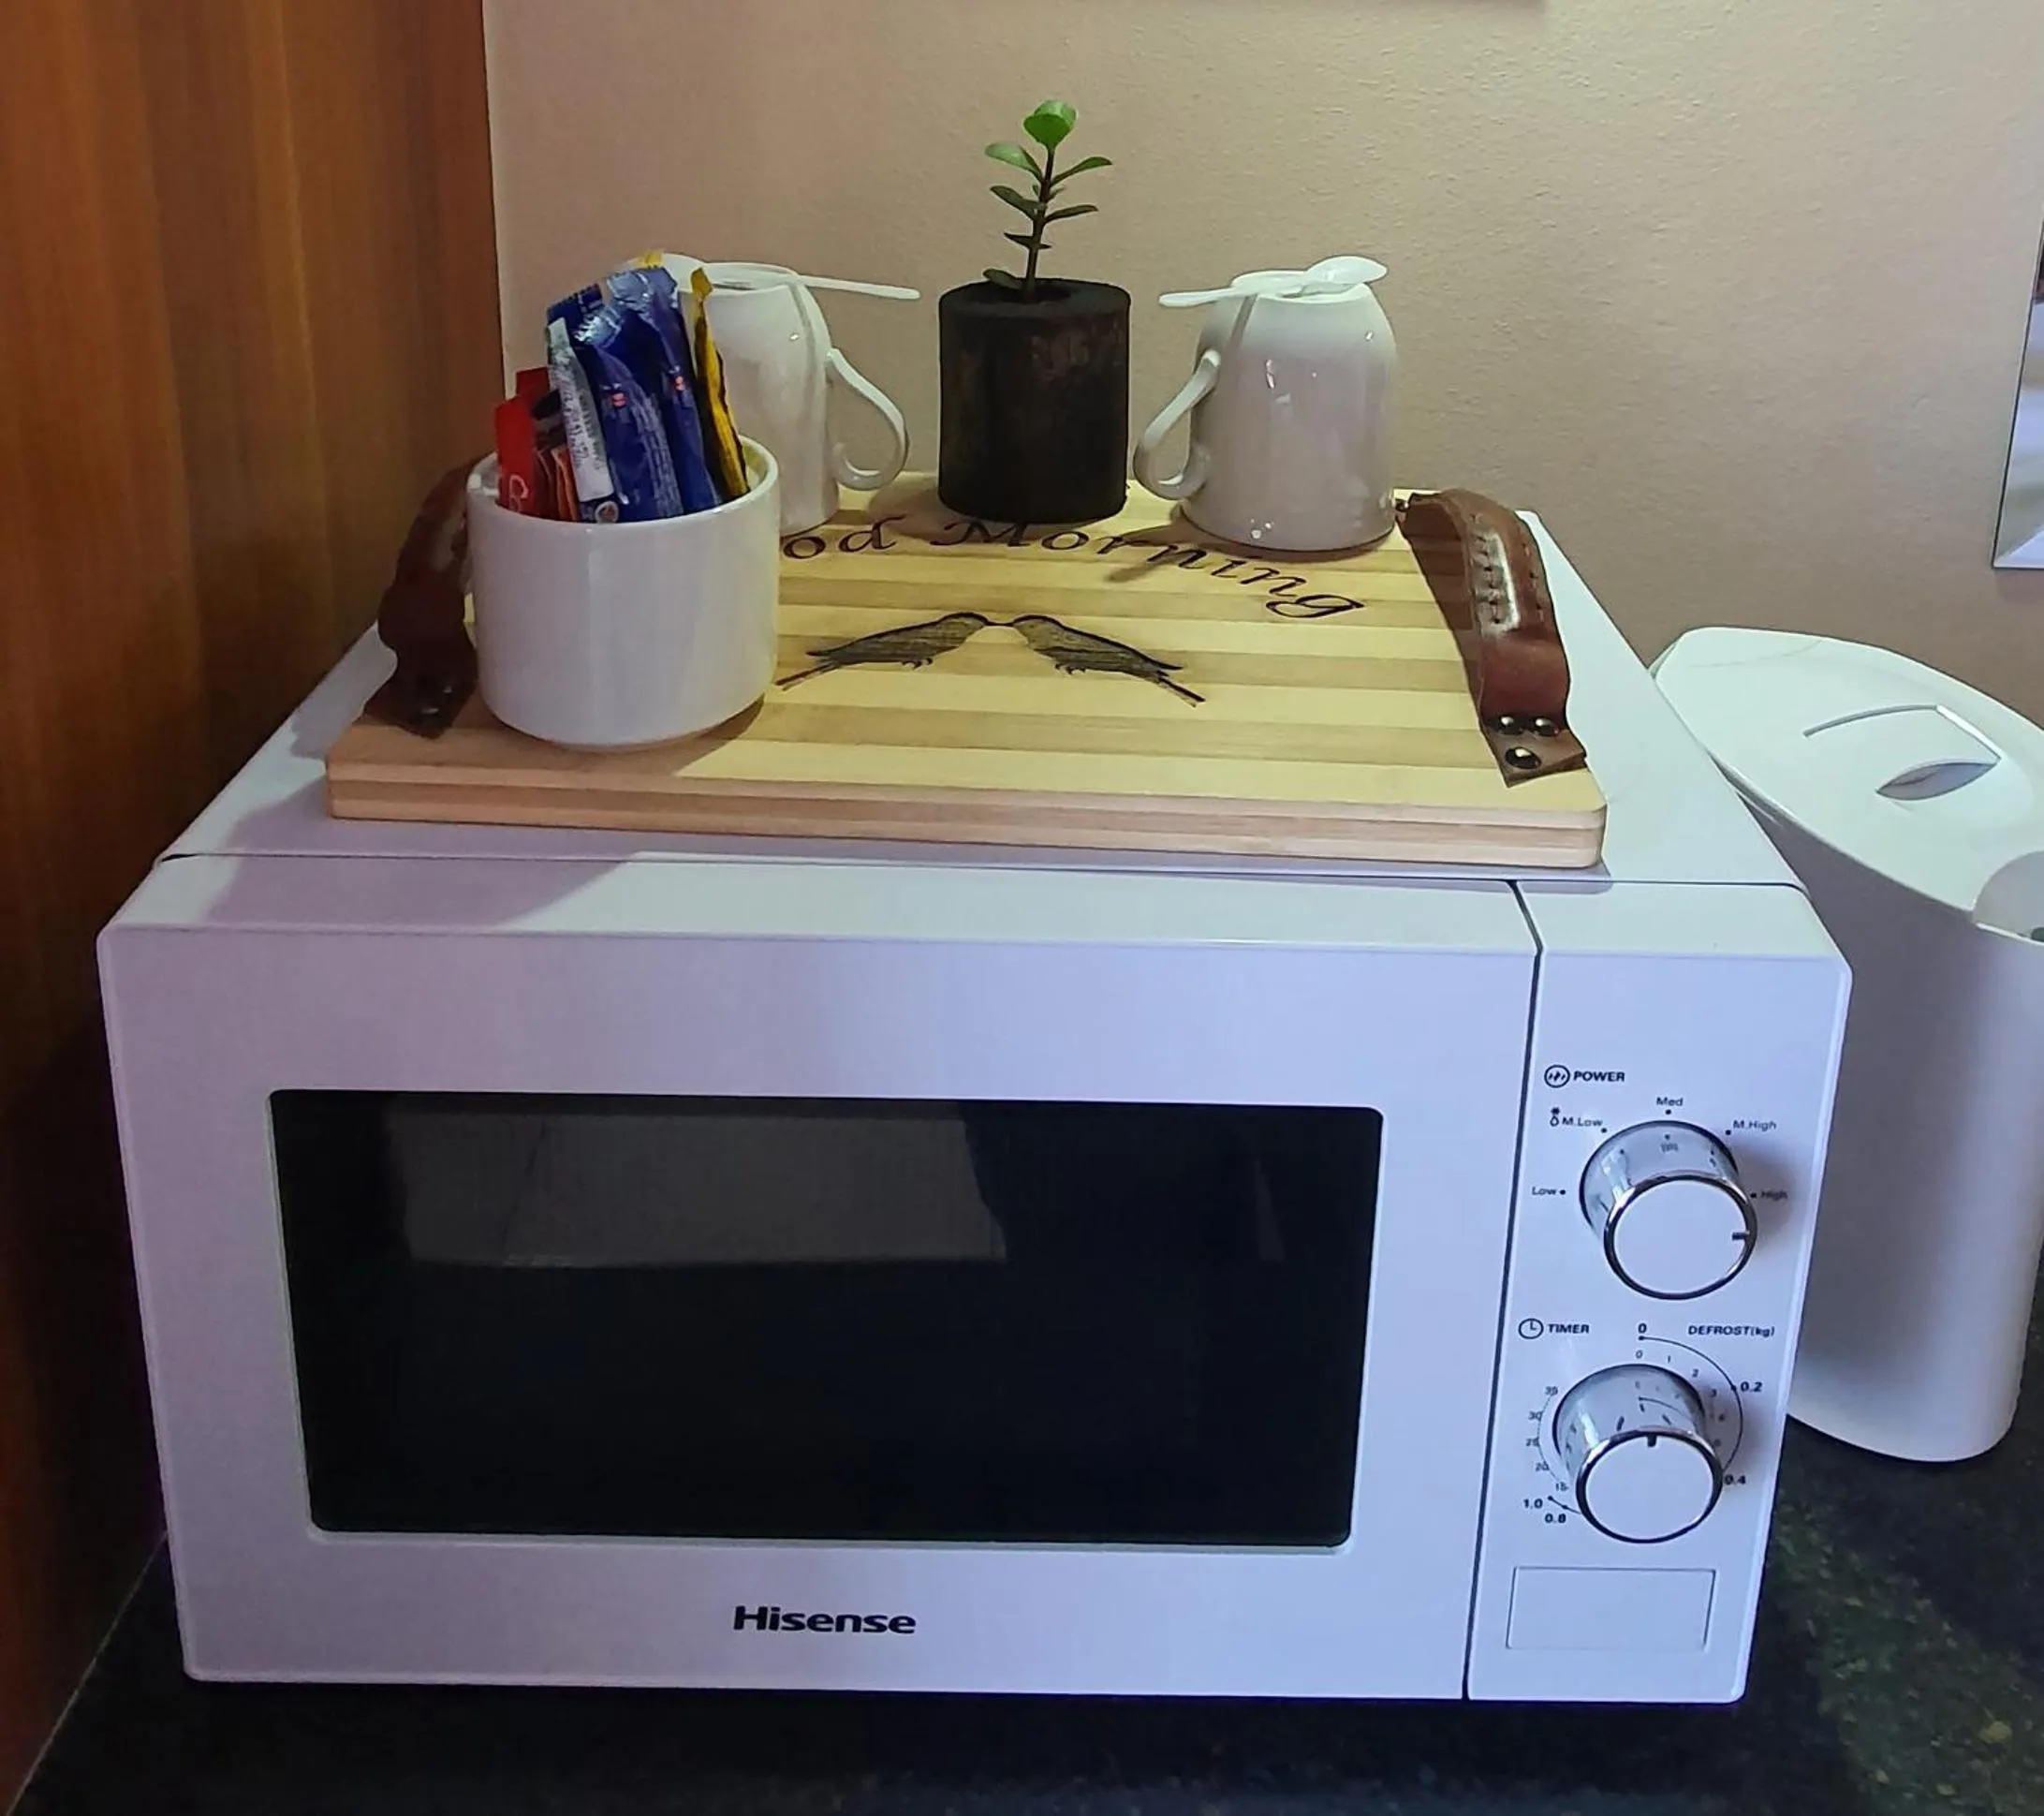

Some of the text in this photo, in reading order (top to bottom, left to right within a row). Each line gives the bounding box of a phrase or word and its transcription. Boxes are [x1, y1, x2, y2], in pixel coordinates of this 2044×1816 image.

[782, 514, 1366, 618] od Morning
[1573, 1070, 1625, 1082] POWER
[1655, 1097, 1684, 1106] Med
[1732, 1119, 1777, 1131] M.High
[1532, 1186, 1557, 1196] Low
[1760, 1190, 1788, 1201] High
[1548, 1323, 1590, 1334] TIMER
[1638, 1322, 1648, 1334] 0
[1687, 1325, 1775, 1338] DEFROST(kg)
[1635, 1350, 1643, 1359] 0
[1739, 1381, 1763, 1393] 0.2
[1528, 1410, 1543, 1421] 30
[1724, 1474, 1747, 1485] 0.4
[1523, 1499, 1544, 1509] 1.0
[1544, 1513, 1566, 1524] 0.8
[733, 1605, 918, 1634] Hisense
